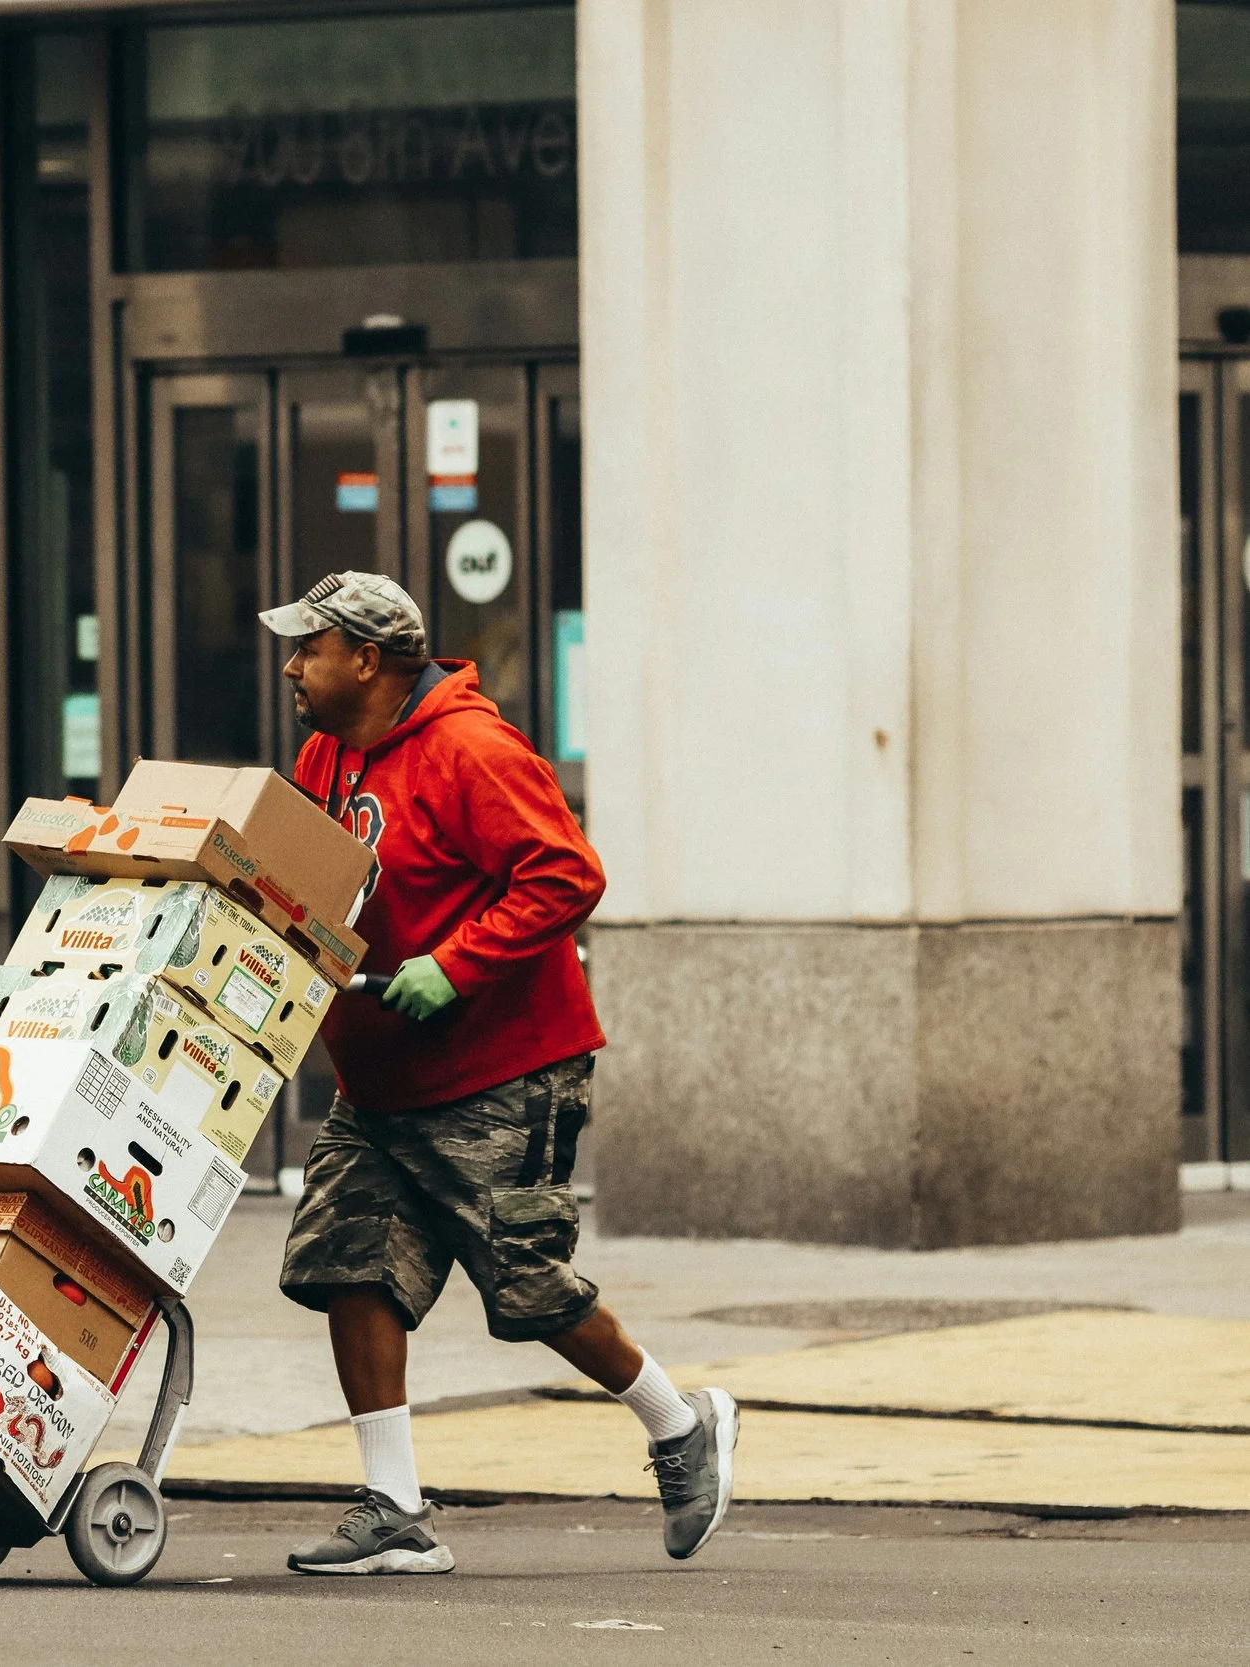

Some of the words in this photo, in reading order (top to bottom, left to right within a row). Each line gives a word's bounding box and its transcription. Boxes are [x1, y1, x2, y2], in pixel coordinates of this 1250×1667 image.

[450, 102, 571, 178] Ave
[18, 806, 77, 829] Driscoll's
[213, 833, 258, 877] Driscoll's
[228, 909, 240, 923] ONE
[240, 916, 257, 935] TODAY
[182, 1011, 197, 1028] TODAY
[114, 1071, 129, 1084] COUNT
[136, 1113, 152, 1129] AND
[151, 1126, 183, 1157] NATURAL
[138, 1101, 163, 1126] FRESH
[162, 1122, 192, 1150] QUALITY
[0, 1205, 18, 1214] SILK
[86, 1197, 111, 1223] PRODUCER
[114, 1224, 140, 1248] EXPORTER
[88, 1173, 155, 1237] CARAVEO
[24, 1226, 62, 1257] LIPMAN
[77, 1262, 100, 1285] SILK
[5, 1318, 20, 1333] LBS.
[22, 1332, 35, 1346] NET
[18, 1313, 31, 1333] NO.
[15, 1339, 30, 1360] kg
[27, 1385, 74, 1440] DRAGON
[12, 1448, 46, 1488] POTATOES
